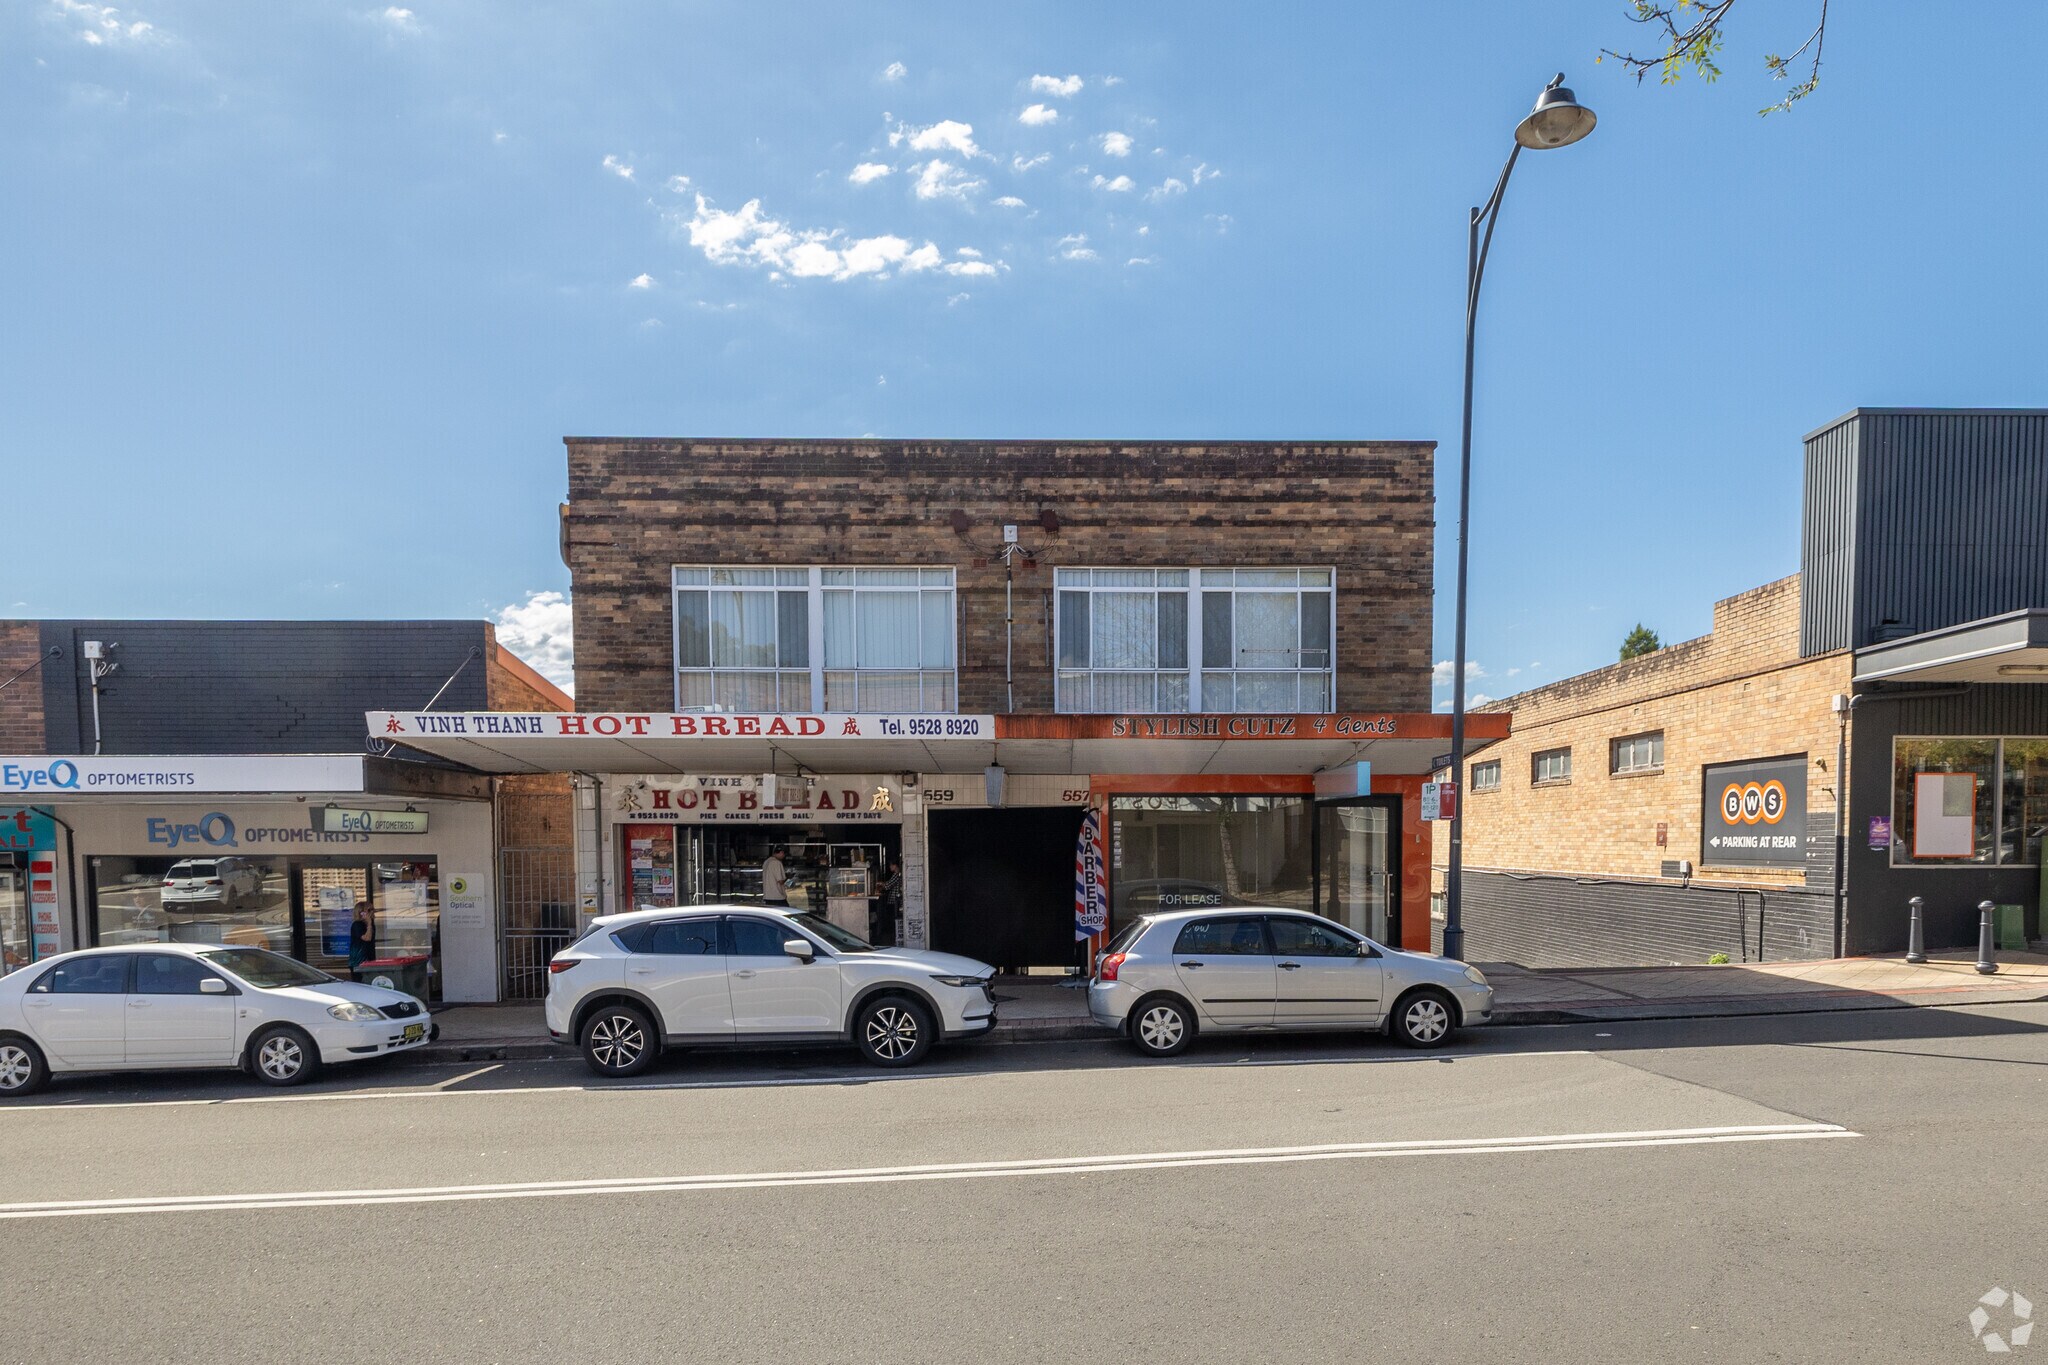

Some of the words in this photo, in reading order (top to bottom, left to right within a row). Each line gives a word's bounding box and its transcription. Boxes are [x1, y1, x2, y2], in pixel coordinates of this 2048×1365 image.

[386, 714, 406, 734] 永
[415, 716, 467, 733] VINH
[473, 716, 544, 734] THANH
[556, 715, 652, 735] HOT
[670, 715, 826, 736] BREAD
[841, 717, 861, 736] 成
[879, 718, 905, 735] Tel.
[909, 718, 942, 735] 9528
[946, 718, 980, 736] 8920
[1112, 717, 1220, 736] STYLISH
[1228, 717, 1296, 736] CUTZ
[1312, 717, 1327, 733] 4
[1335, 716, 1397, 734] Gents
[3, 759, 81, 790] EyeQ
[87, 772, 195, 786] OPTOMETRISTS
[698, 777, 742, 787] VINH
[652, 788, 721, 810] HOT
[738, 789, 860, 810] BAD
[869, 786, 894, 812] 成
[923, 790, 954, 801] 559
[1062, 790, 1090, 801] 557
[1426, 784, 1436, 795] 1P
[1728, 794, 1777, 811] BWS
[146, 811, 238, 848] EyeQ
[245, 828, 370, 843] OPTOMETRISTS
[342, 810, 372, 832] EyeQ
[375, 820, 415, 831] OPTOMETRISTS
[1722, 836, 1758, 848] PARKING
[1759, 836, 1771, 848] AT
[1772, 836, 1797, 848] REAR
[1084, 826, 1098, 914] BARBER
[1159, 894, 1181, 904] FOR
[1185, 894, 1221, 904] LEASE
[1081, 916, 1104, 925] SHOP
